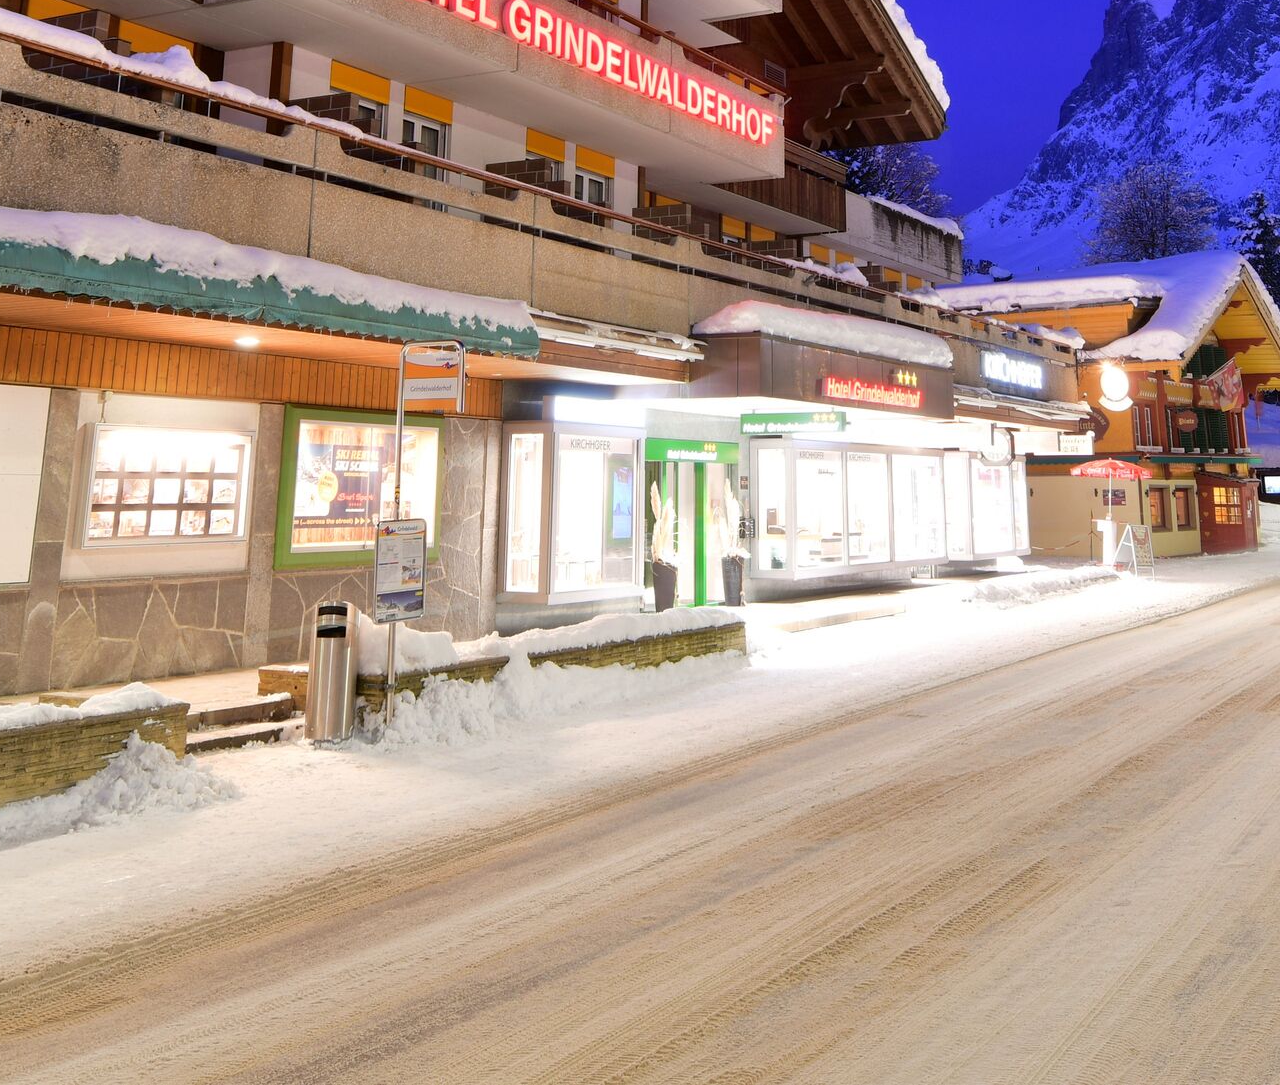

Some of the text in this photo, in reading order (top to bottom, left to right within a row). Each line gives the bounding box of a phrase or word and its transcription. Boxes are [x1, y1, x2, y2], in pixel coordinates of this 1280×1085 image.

[410, 384, 452, 392] Grindelwalderhof
[827, 377, 921, 409] Hotel Grindelwalderhof
[1079, 419, 1095, 430] inte
[570, 438, 611, 451] KIRCHHOFER
[336, 449, 350, 460] SKI
